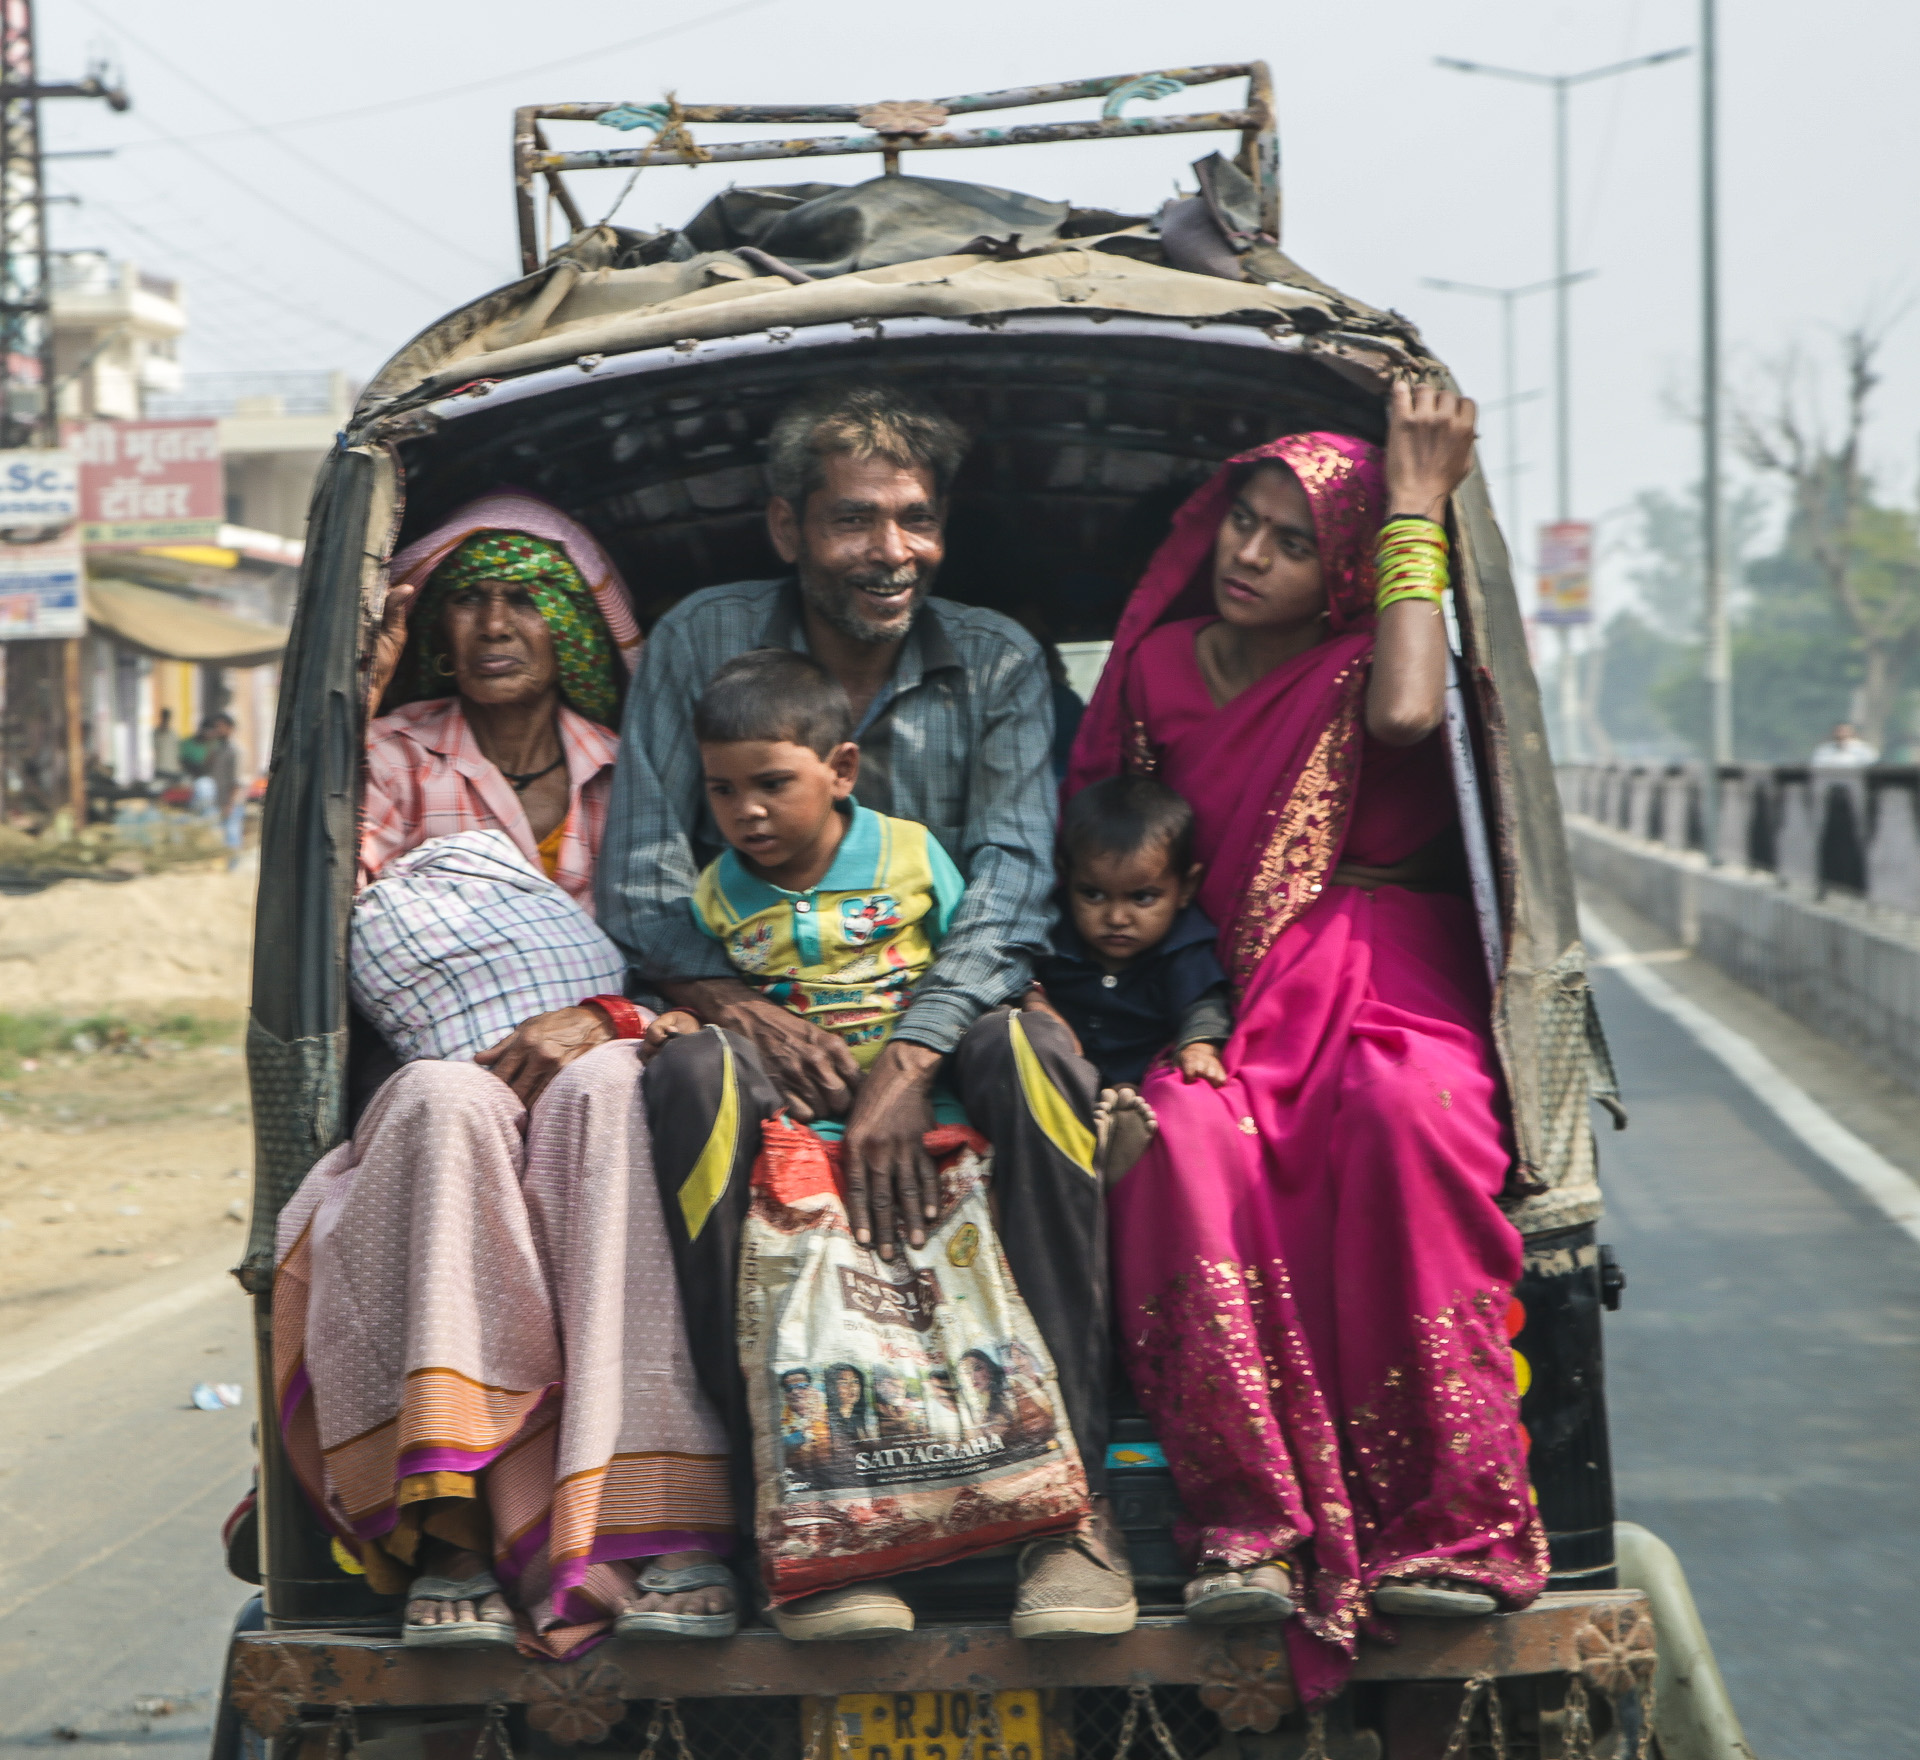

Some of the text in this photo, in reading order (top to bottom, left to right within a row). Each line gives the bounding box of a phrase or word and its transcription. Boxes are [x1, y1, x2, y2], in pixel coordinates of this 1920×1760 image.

[0, 463, 75, 492] Sc.
[845, 1271, 933, 1306] INDI
[851, 1291, 933, 1322] GAT
[855, 1433, 1006, 1470] SATYAGRAHA
